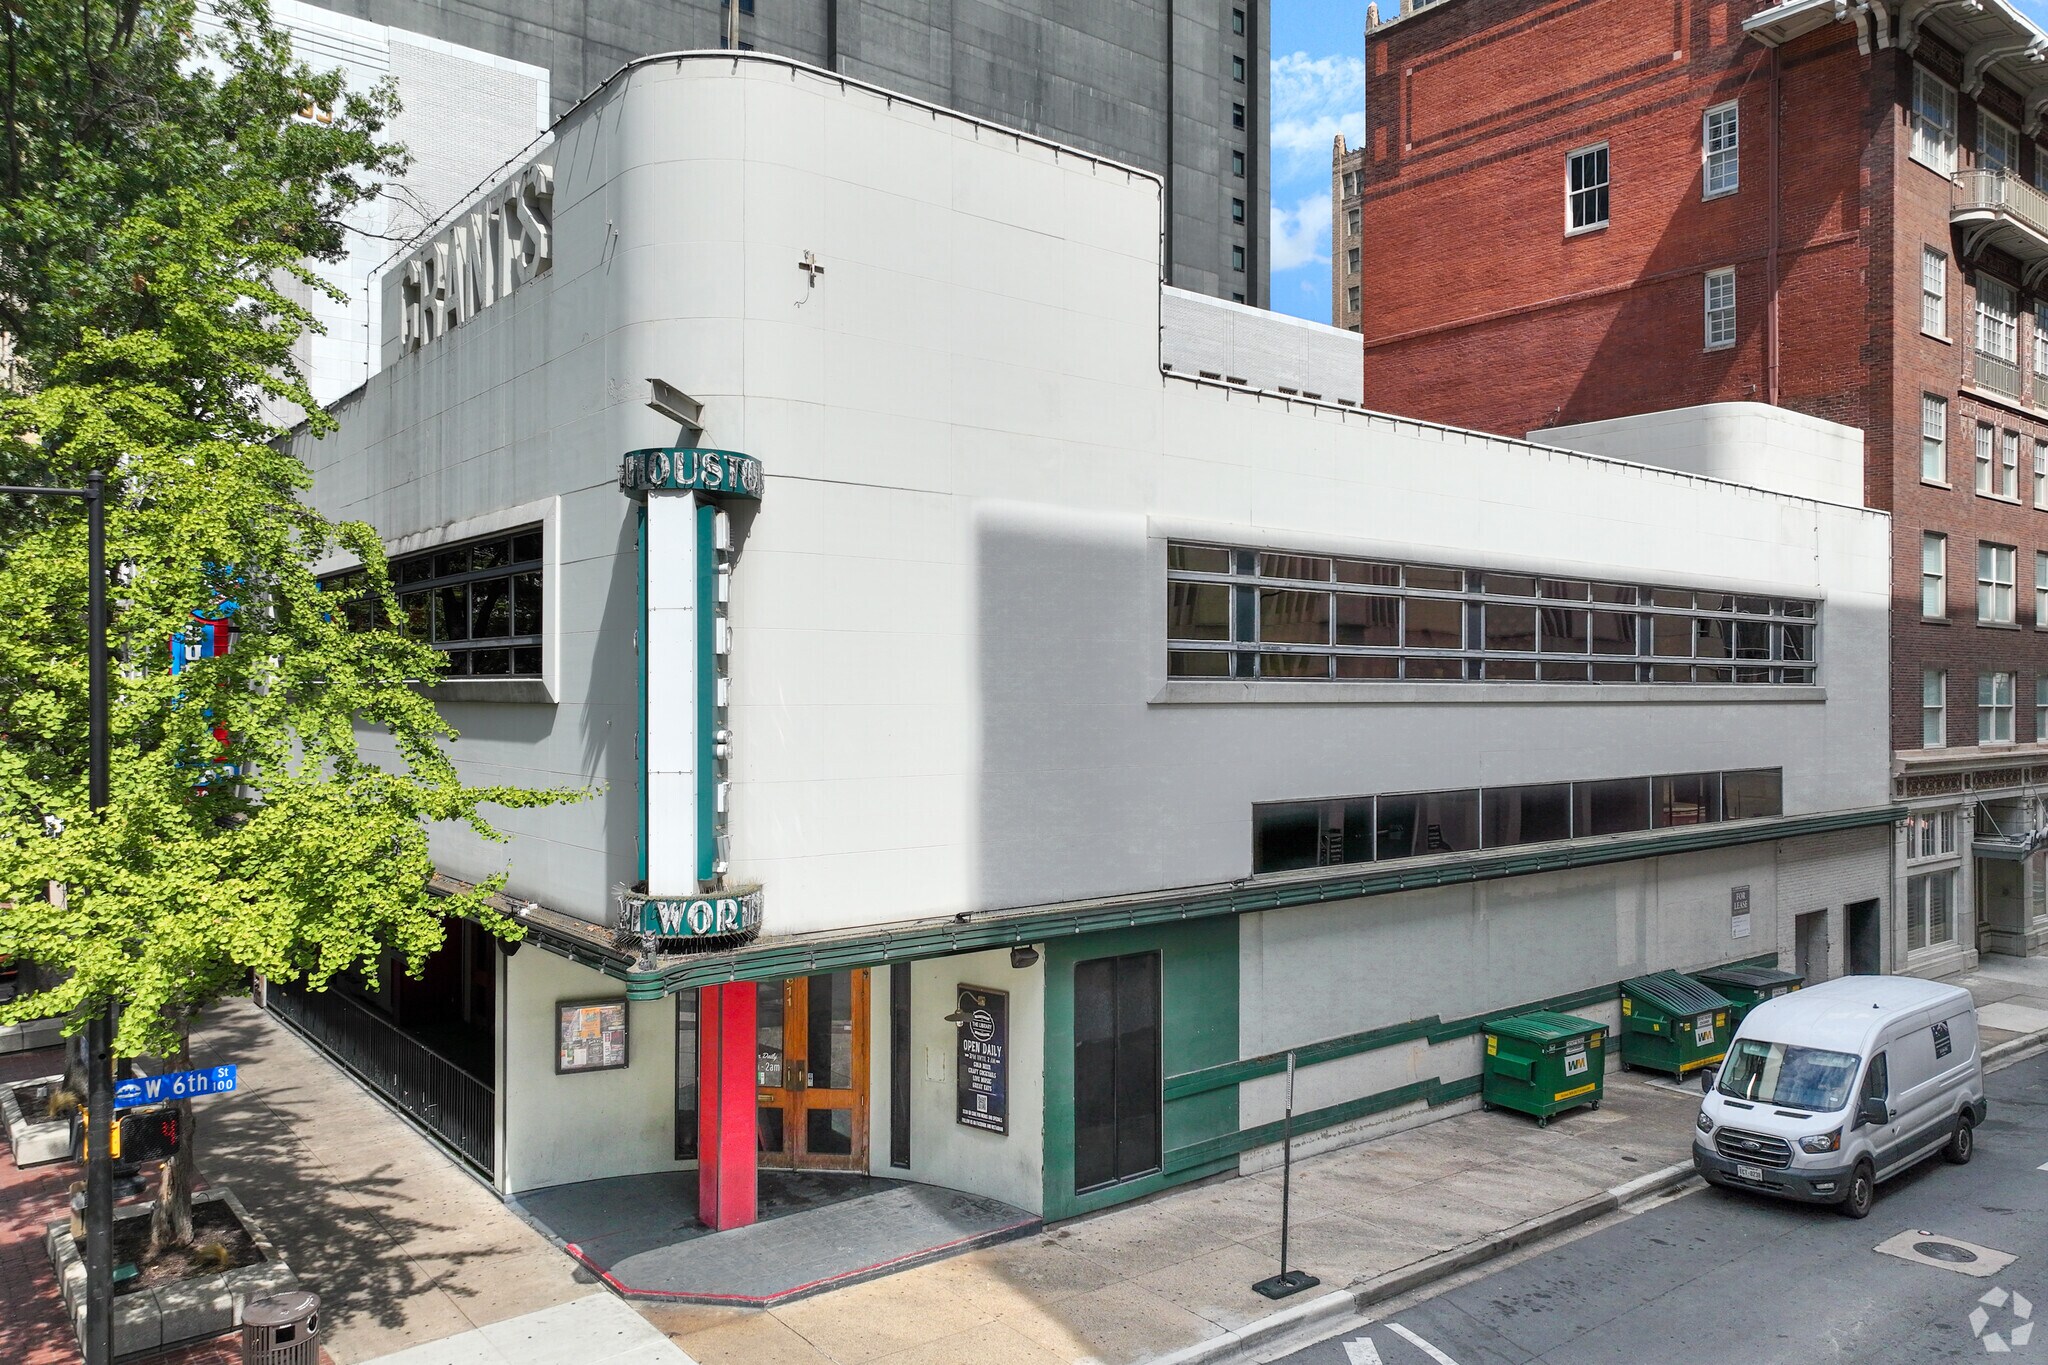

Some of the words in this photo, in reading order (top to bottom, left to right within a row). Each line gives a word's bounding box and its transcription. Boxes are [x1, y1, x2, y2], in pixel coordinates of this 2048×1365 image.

[1735, 891, 1747, 901] FOR
[1733, 900, 1748, 910] LEASE
[1697, 1030, 1712, 1042] WM
[964, 1039, 980, 1053] OPEN
[983, 1043, 1001, 1057] DAILY
[762, 1052, 778, 1061] Daily
[765, 1062, 780, 1072] 2am
[1567, 1057, 1586, 1071] WM
[217, 1067, 229, 1078] St
[145, 1078, 162, 1099] W
[173, 1073, 208, 1095] 6th
[212, 1079, 233, 1092] 100
